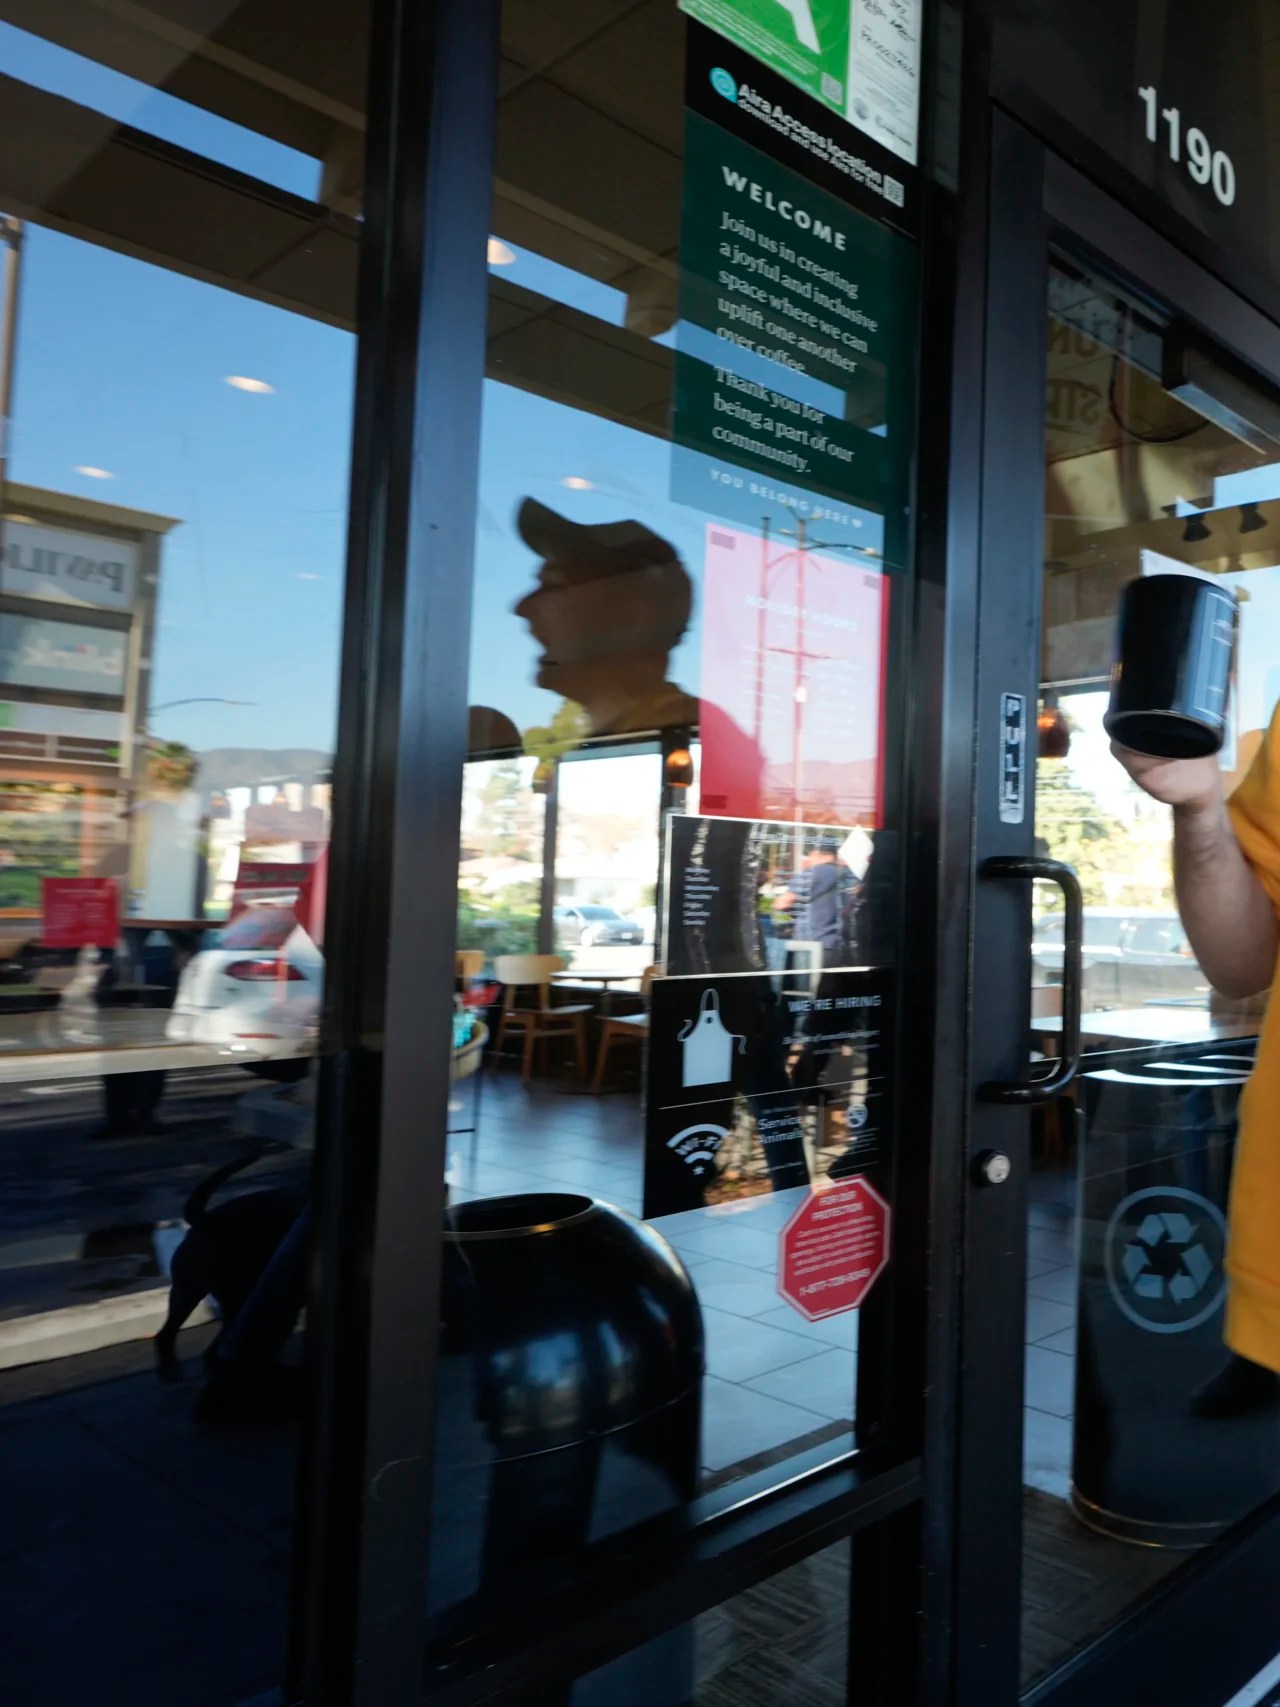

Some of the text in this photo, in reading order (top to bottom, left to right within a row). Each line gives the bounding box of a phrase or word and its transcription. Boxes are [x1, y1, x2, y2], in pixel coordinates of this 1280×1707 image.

[738, 83, 772, 114] Aira
[772, 105, 827, 148] Access
[1138, 86, 1236, 206] 1190
[721, 166, 846, 251] WELCOME
[719, 211, 859, 300] Join us in creating
[719, 242, 878, 332] a joyful and inclusive
[716, 327, 756, 352] over
[717, 298, 858, 373] uplift one another
[718, 270, 868, 353] space where we can
[714, 365, 827, 425] Thank you for
[714, 392, 855, 462] being a part of our
[712, 426, 812, 473] community.
[710, 468, 849, 525] YOU BELONG HERE
[1004, 699, 1021, 801] PULL
